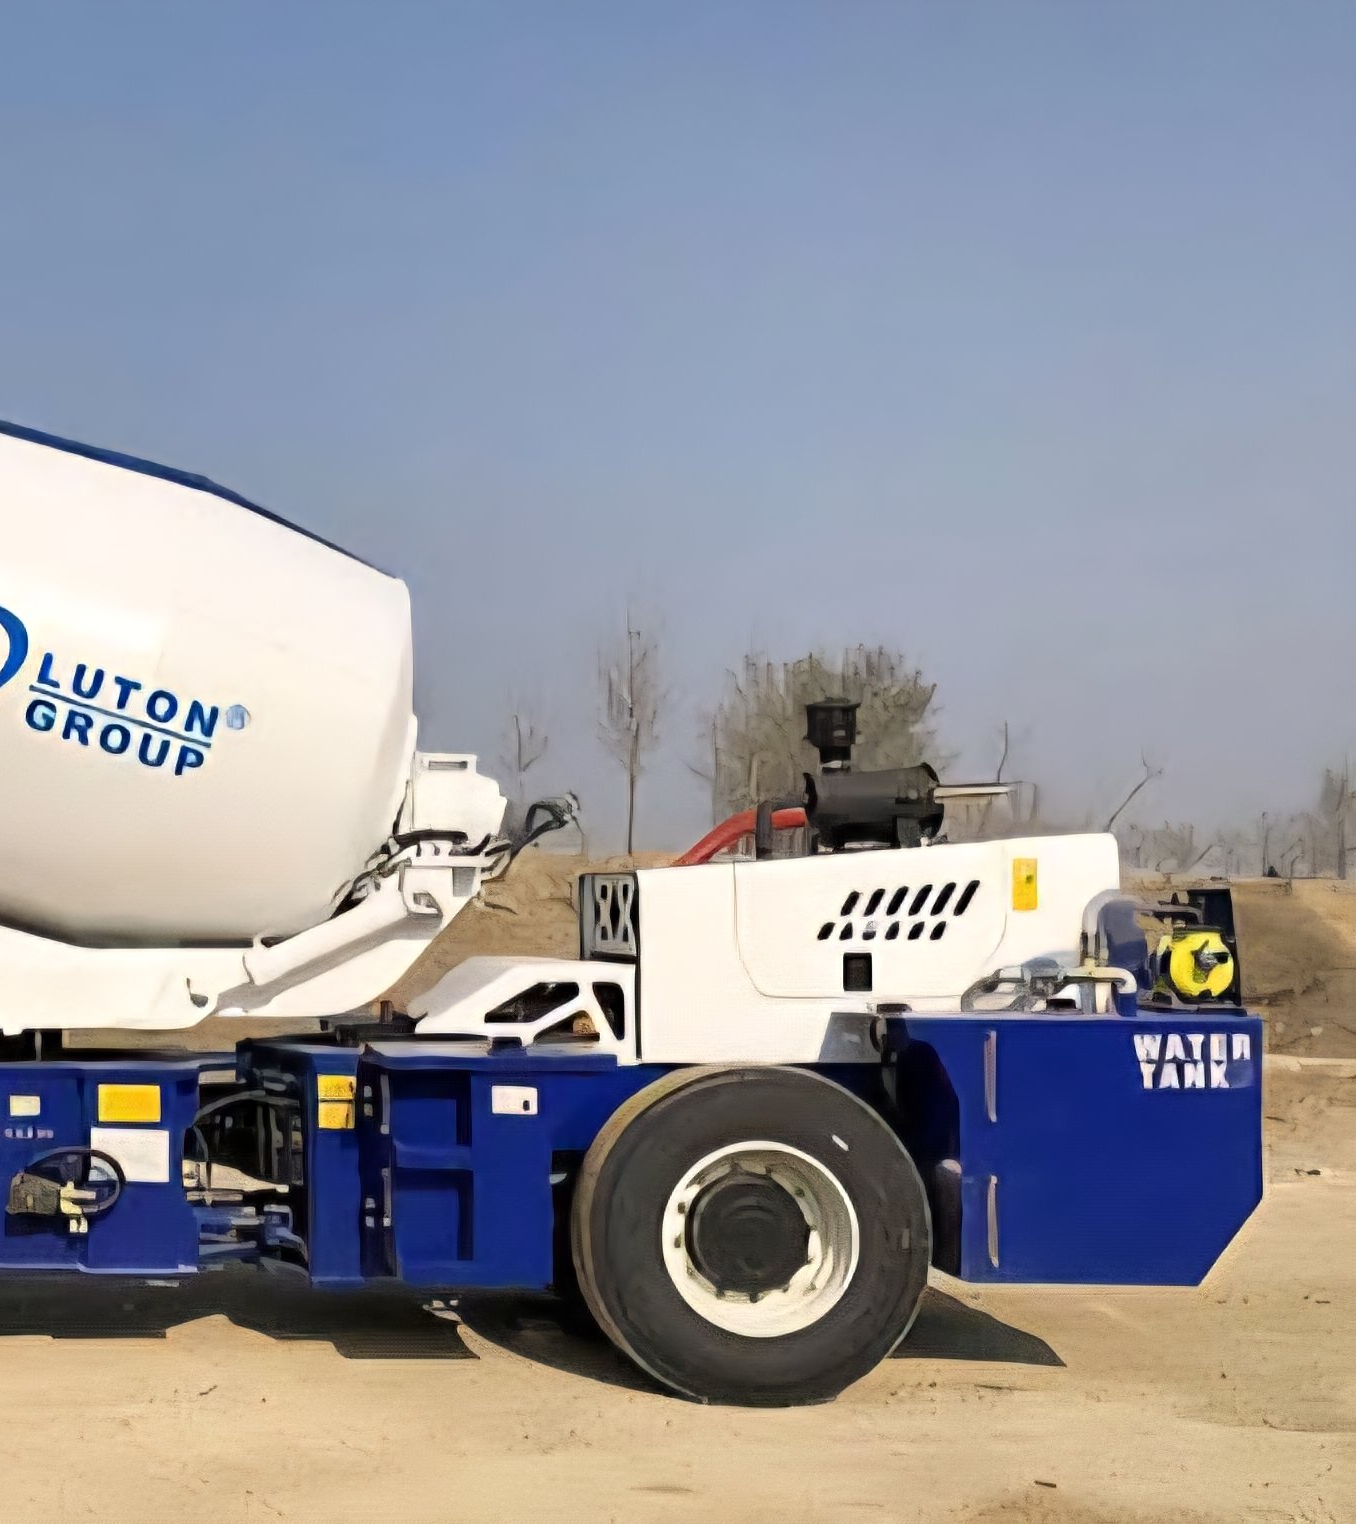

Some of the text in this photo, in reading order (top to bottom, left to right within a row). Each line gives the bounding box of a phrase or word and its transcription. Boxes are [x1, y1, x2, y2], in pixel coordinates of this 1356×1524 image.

[36, 652, 219, 738] LUTON
[25, 698, 205, 776] GROUP
[1140, 1062, 1230, 1089] TANK
